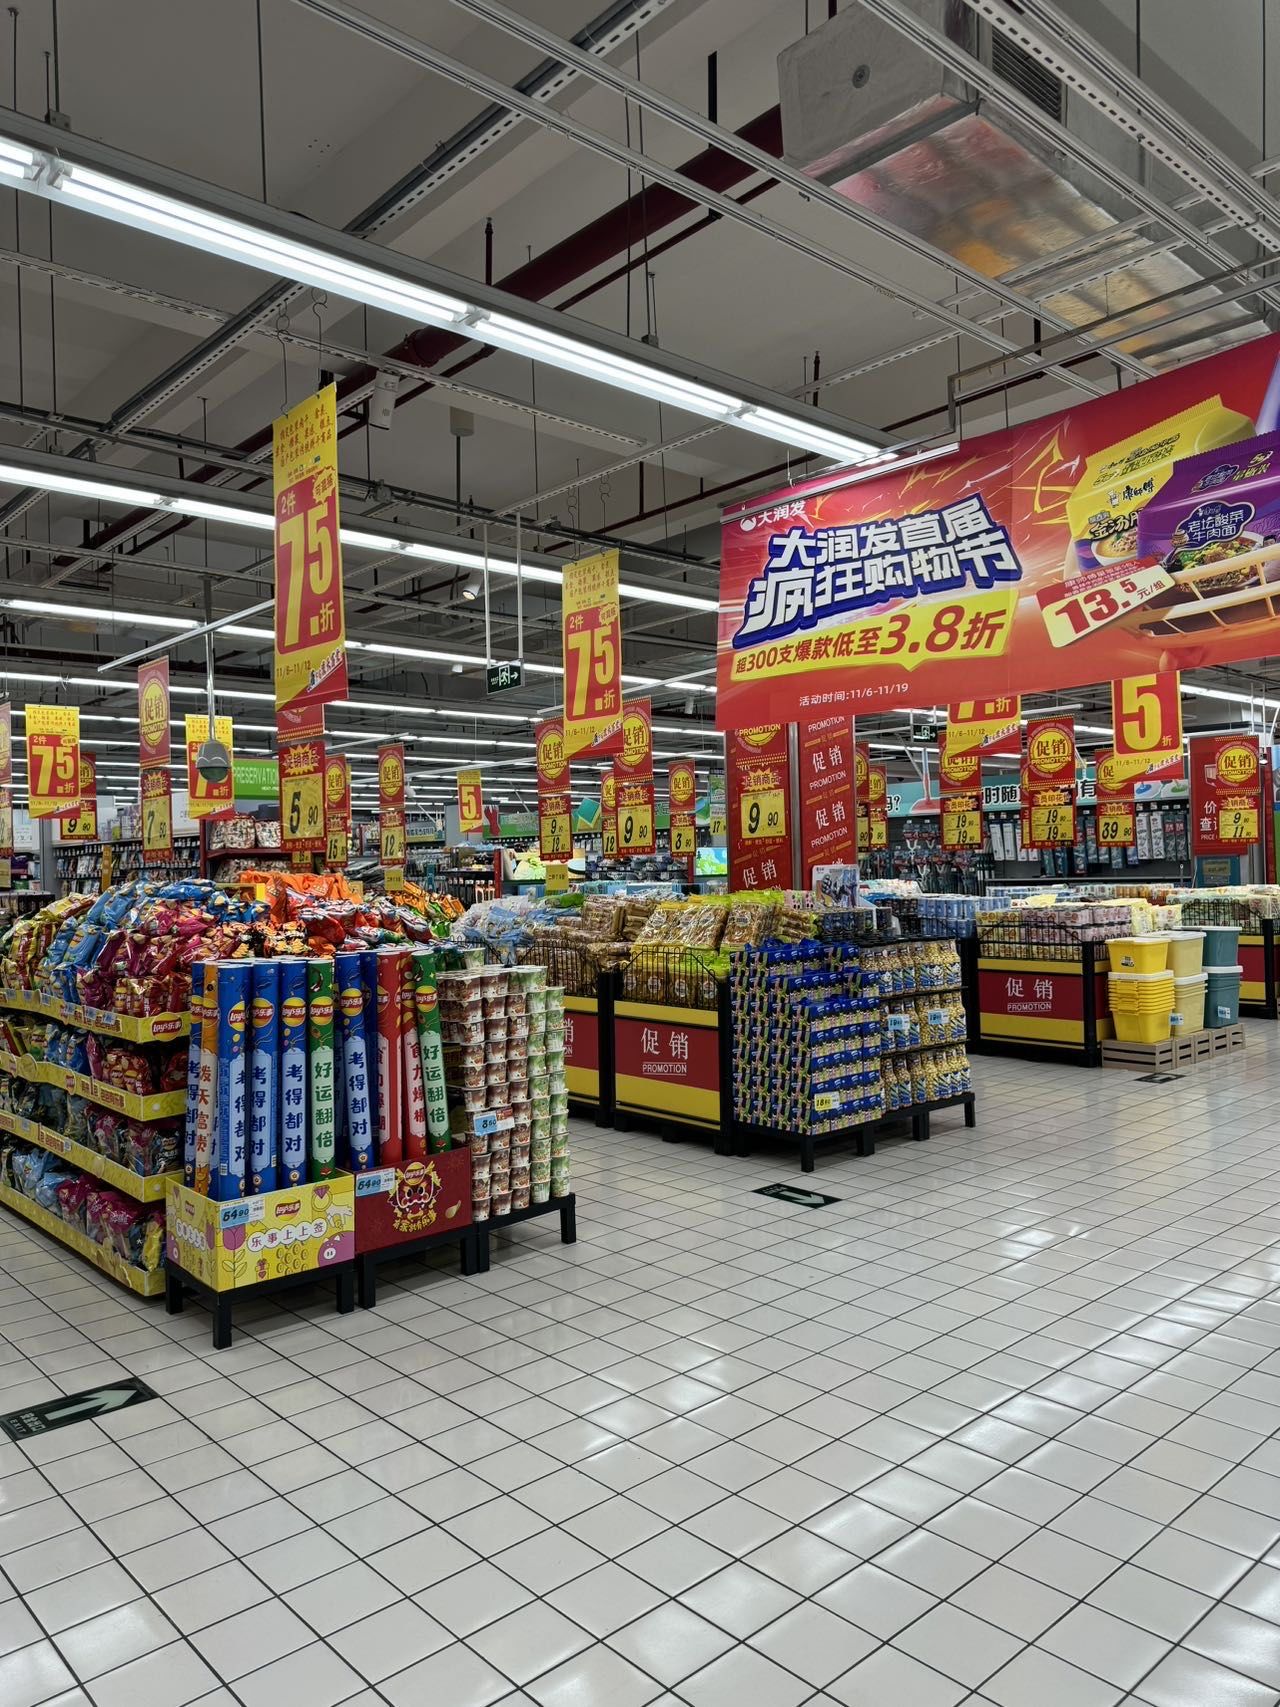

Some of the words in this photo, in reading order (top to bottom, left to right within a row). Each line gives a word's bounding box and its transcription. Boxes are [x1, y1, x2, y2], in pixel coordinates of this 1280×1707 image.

[281, 491, 296, 516] 2件
[757, 499, 806, 526] 大润发
[1188, 509, 1244, 533] 老坛酸菜
[768, 497, 994, 569] 大润发首届
[1192, 525, 1237, 541] 牛肉面
[738, 528, 1022, 636] 疯狂购物节
[569, 614, 584, 631] 2件
[145, 694, 164, 724] 促销
[141, 722, 168, 737] PROMOTION
[565, 726, 596, 737] 11/6-11/12
[739, 723, 782, 737] PROMOTION
[808, 715, 845, 733] PROMOTION
[33, 735, 47, 745] 2件
[1036, 738, 1067, 757] 促销
[542, 741, 564, 763] 促销
[616, 747, 649, 759] PROMOTION
[812, 744, 843, 773] 促销
[1031, 756, 1072, 766] PROMOTION
[1224, 754, 1251, 769] 促销
[233, 767, 278, 784] PRESERVATIO
[383, 764, 399, 782] 促销
[538, 760, 568, 772] PROMOTION
[943, 765, 978, 774] PROMOTION
[328, 773, 343, 788] 促销
[673, 776, 691, 791] 促销
[809, 770, 847, 791] PROMOTION
[290, 790, 302, 834] 5
[308, 805, 319, 826] 90
[748, 802, 761, 834] 9
[767, 811, 779, 826] 90
[815, 800, 846, 830] 促销
[956, 814, 967, 829] 19
[1046, 809, 1058, 824] 19
[1233, 812, 1241, 824] 9
[624, 815, 634, 845] 9
[638, 826, 648, 839] 90
[811, 826, 848, 849] PROMOTION
[957, 830, 967, 844] 19
[1046, 826, 1059, 840] 19
[1102, 821, 1119, 840] 39
[1233, 825, 1245, 838] 11
[384, 834, 396, 857] 12
[742, 859, 777, 888] 促销
[1005, 977, 1054, 1000] 促销
[1007, 1002, 1052, 1012] PROMOTION
[641, 1027, 689, 1060] 促销
[642, 1063, 687, 1074] PROMOTION
[347, 1050, 370, 1137] 考得都对
[422, 1044, 446, 1124] 好运翻倍
[251, 1066, 267, 1157] 考得都对
[284, 1063, 304, 1153] 考得都对
[314, 1061, 335, 1149] 好运翻倍
[250, 1221, 324, 1248] 乐事上上签
[9, 1418, 27, 1434] EXIT
